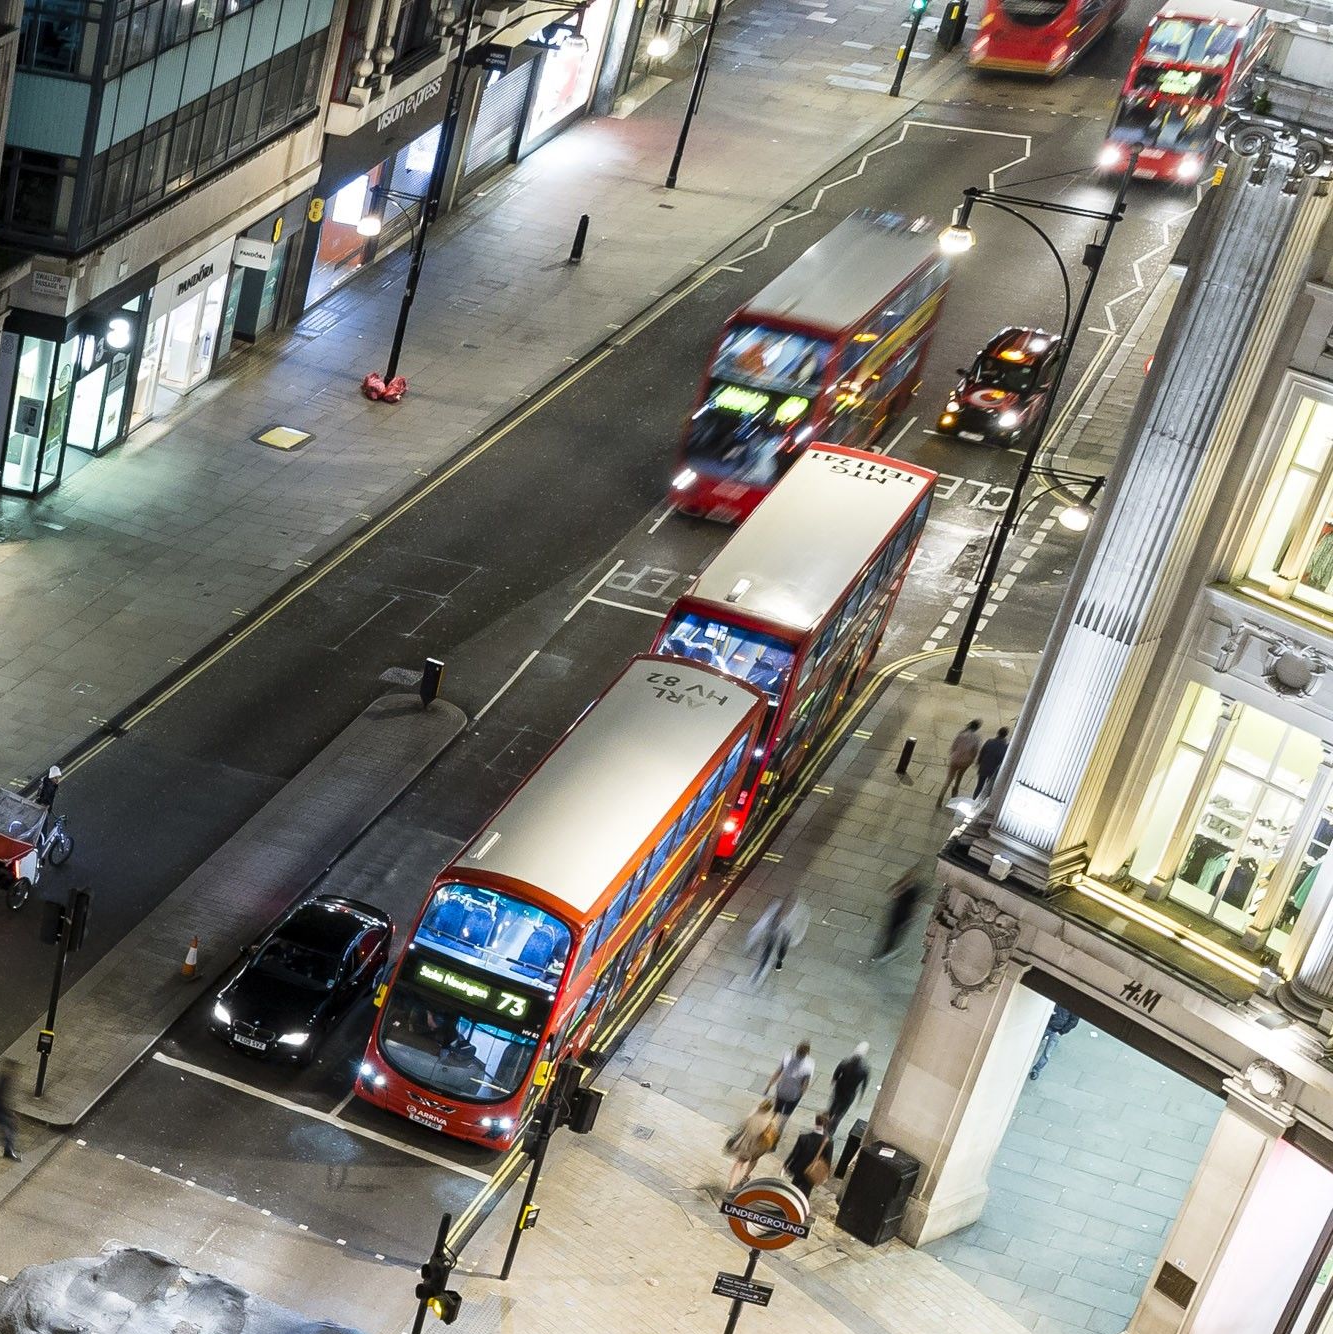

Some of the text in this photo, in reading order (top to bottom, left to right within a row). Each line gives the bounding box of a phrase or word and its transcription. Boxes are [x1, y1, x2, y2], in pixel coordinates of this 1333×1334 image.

[376, 104, 404, 133] vision
[106, 318, 130, 349] 3
[829, 465, 887, 485] MTG
[646, 672, 729, 707] HV 82
[652, 686, 706, 710] ARL
[497, 992, 527, 1016] 73
[1119, 980, 1163, 1014] H&M
[417, 1110, 447, 1126] ARRIVA
[724, 1204, 806, 1236] UNDERGROUND
